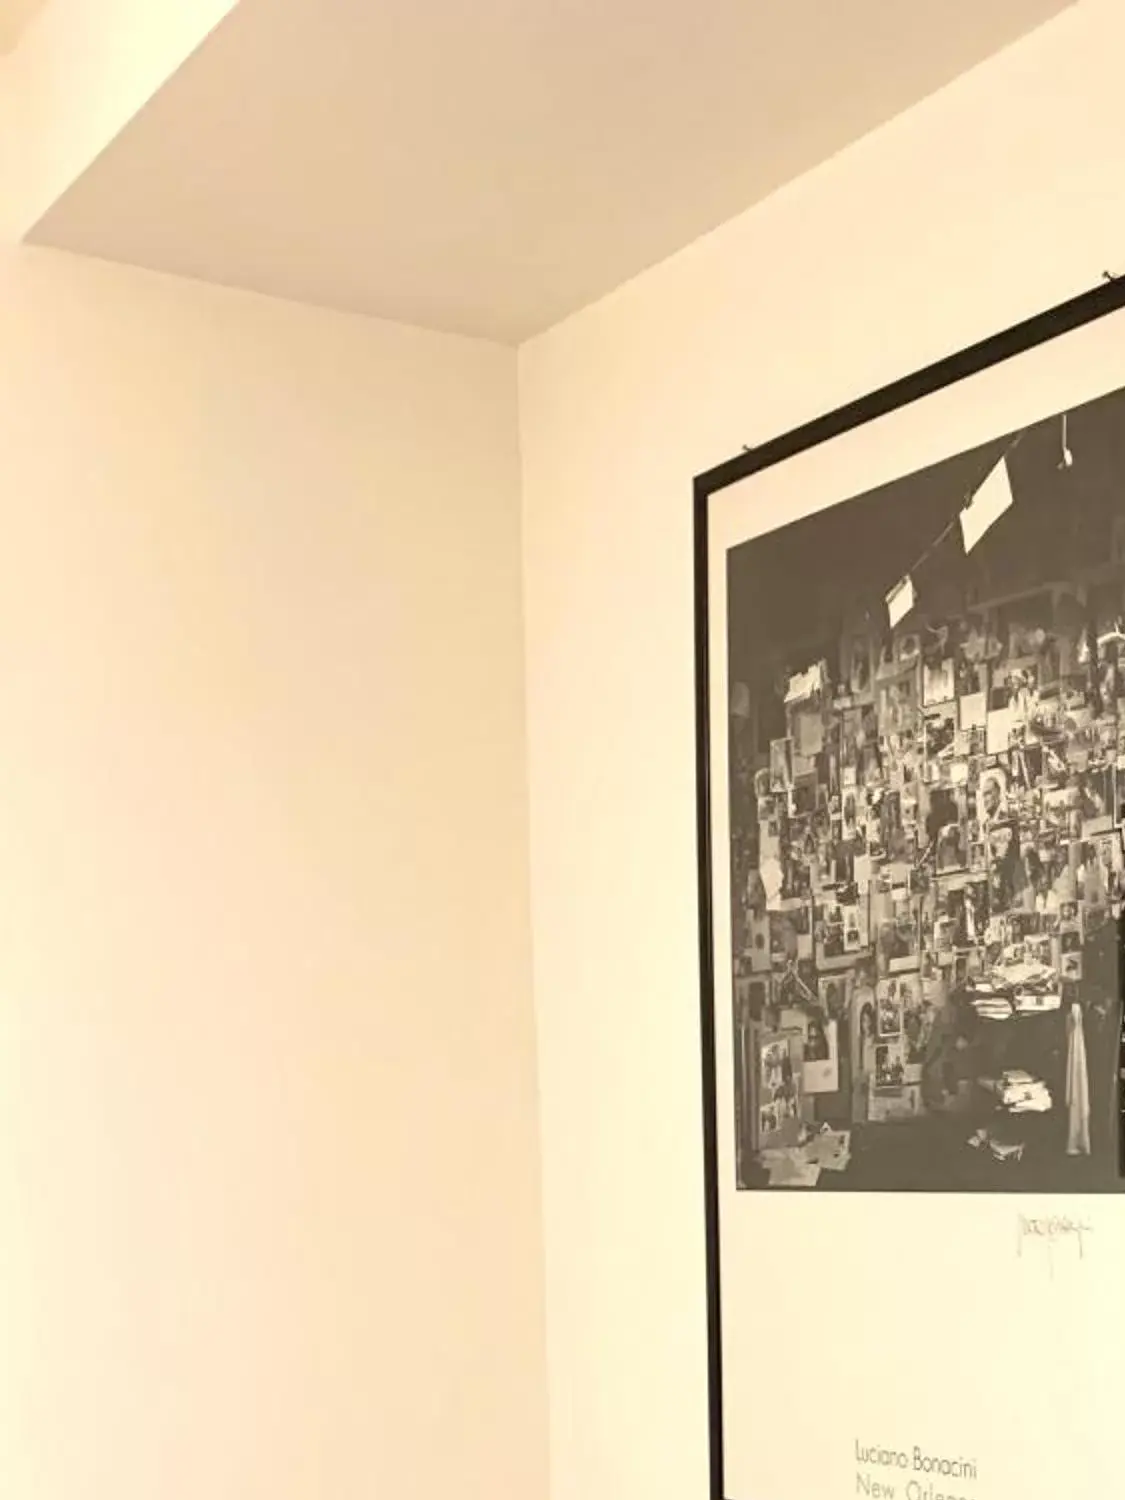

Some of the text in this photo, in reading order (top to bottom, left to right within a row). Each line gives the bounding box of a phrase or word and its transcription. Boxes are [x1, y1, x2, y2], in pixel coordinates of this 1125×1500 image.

[854, 1438, 977, 1480] Luciano Bonacini
[855, 1471, 895, 1500] New
